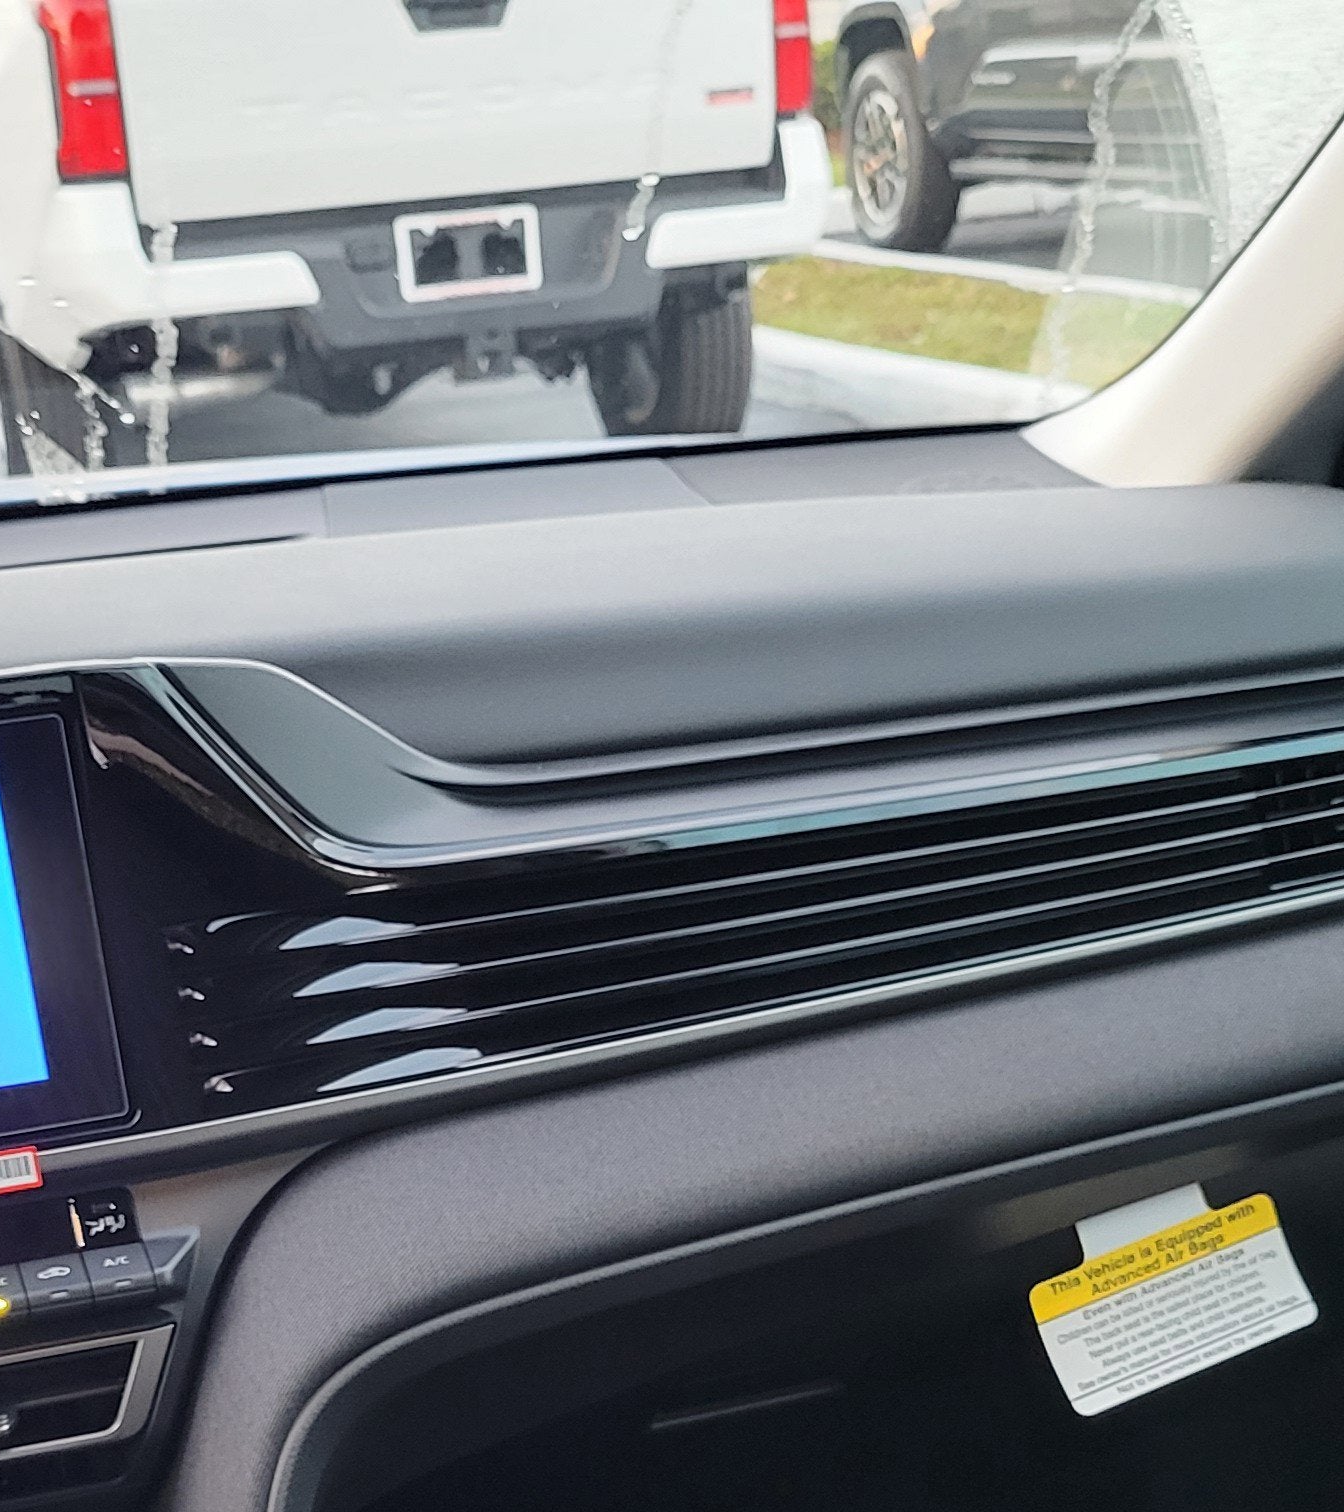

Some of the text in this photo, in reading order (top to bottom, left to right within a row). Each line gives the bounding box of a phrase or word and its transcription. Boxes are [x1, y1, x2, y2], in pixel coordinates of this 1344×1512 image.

[103, 1254, 130, 1267] A/C
[1049, 1276, 1080, 1294] This
[1083, 1254, 1134, 1279] Vehicle
[1155, 1216, 1222, 1251] Equipped
[1226, 1204, 1255, 1222] with
[1091, 1233, 1224, 1294] Advanced Air Bags
[1082, 1248, 1244, 1320] Even with Advanced Air Bags
